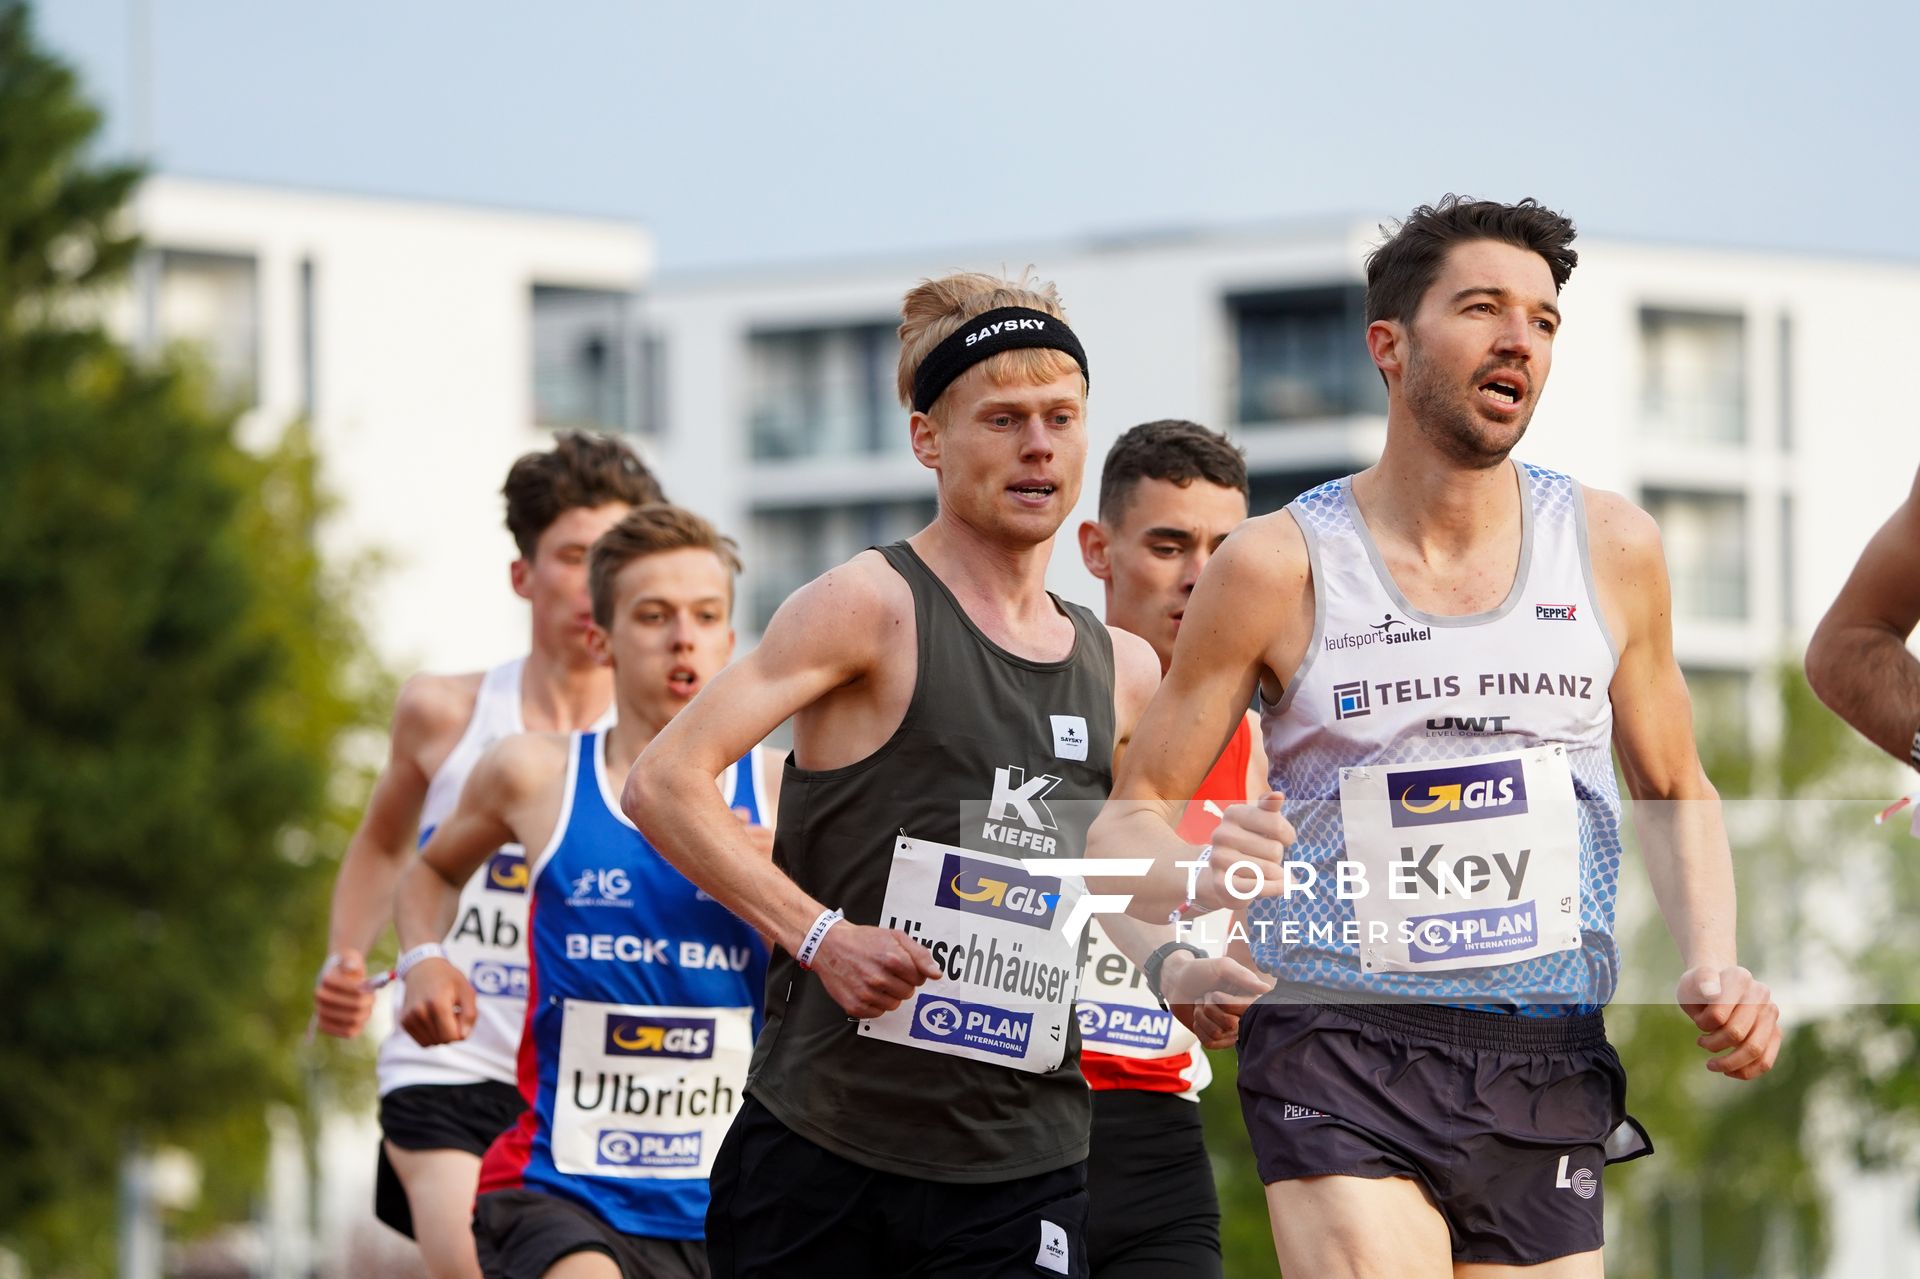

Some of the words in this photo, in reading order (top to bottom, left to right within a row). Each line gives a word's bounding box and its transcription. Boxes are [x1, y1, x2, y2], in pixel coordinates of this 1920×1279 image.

[964, 319, 1046, 347] SAYSKY
[1375, 675, 1461, 706] TELIS
[1479, 672, 1593, 700] FINANZ
[1426, 715, 1510, 732] UWT
[1426, 730, 1455, 738] LEVEL
[1463, 776, 1514, 810] GLS
[982, 822, 1057, 855] KIEFER
[1400, 843, 1531, 901] Key
[1006, 886, 1051, 917] GLS
[1561, 896, 1571, 914] 57
[454, 907, 519, 949] Ab
[1463, 911, 1533, 940] PLAN
[565, 933, 670, 965] BECK
[679, 941, 750, 972] BAU
[1465, 935, 1533, 951] INTERNATIONAL
[966, 1012, 1030, 1043] PLAN
[1050, 1025, 1061, 1042] 17
[1108, 1010, 1170, 1036] PLAN
[664, 1027, 710, 1055] GLS
[964, 1033, 1023, 1054] INTERNATIONAL
[572, 1070, 735, 1117] Ulbrich
[640, 1136, 701, 1157] PLAN
[1556, 1155, 1598, 1199] LG
